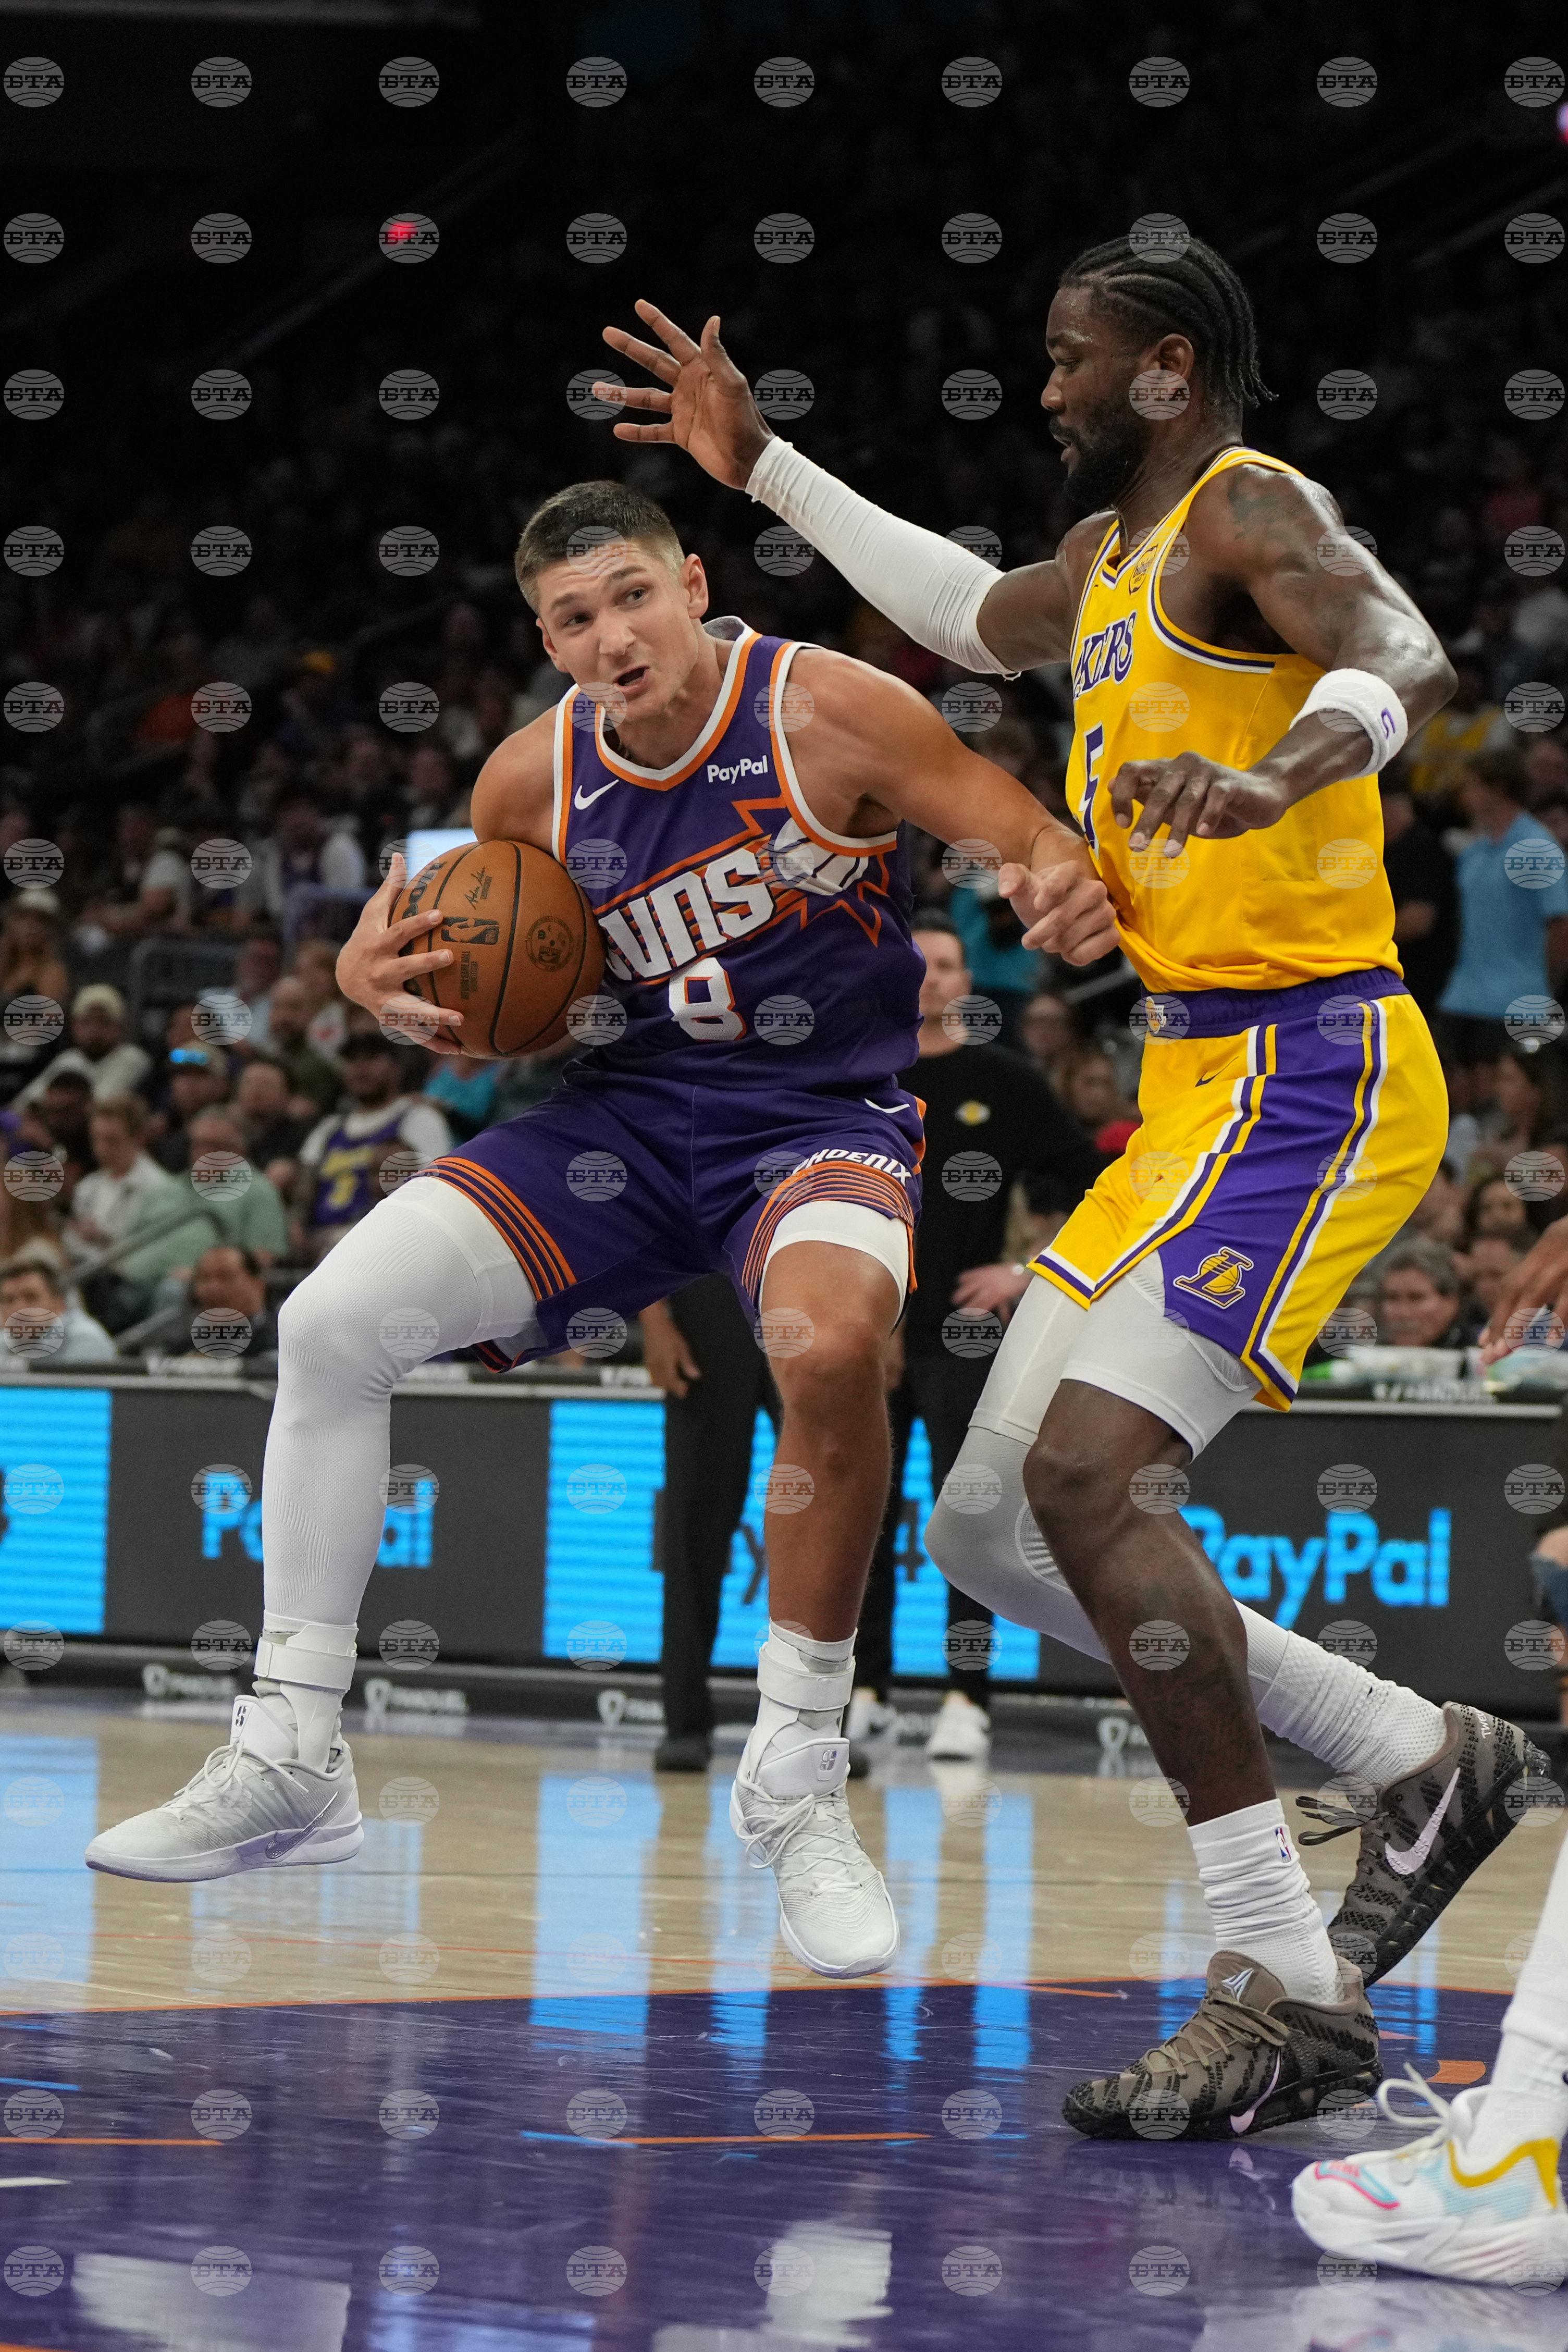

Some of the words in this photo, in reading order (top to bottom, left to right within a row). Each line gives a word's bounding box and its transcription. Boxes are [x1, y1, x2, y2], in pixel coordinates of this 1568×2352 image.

[707, 755, 768, 784] PayPal
[598, 848, 774, 981] UNS
[669, 957, 747, 1041] 8
[792, 1149, 912, 1187] PHOENIX
